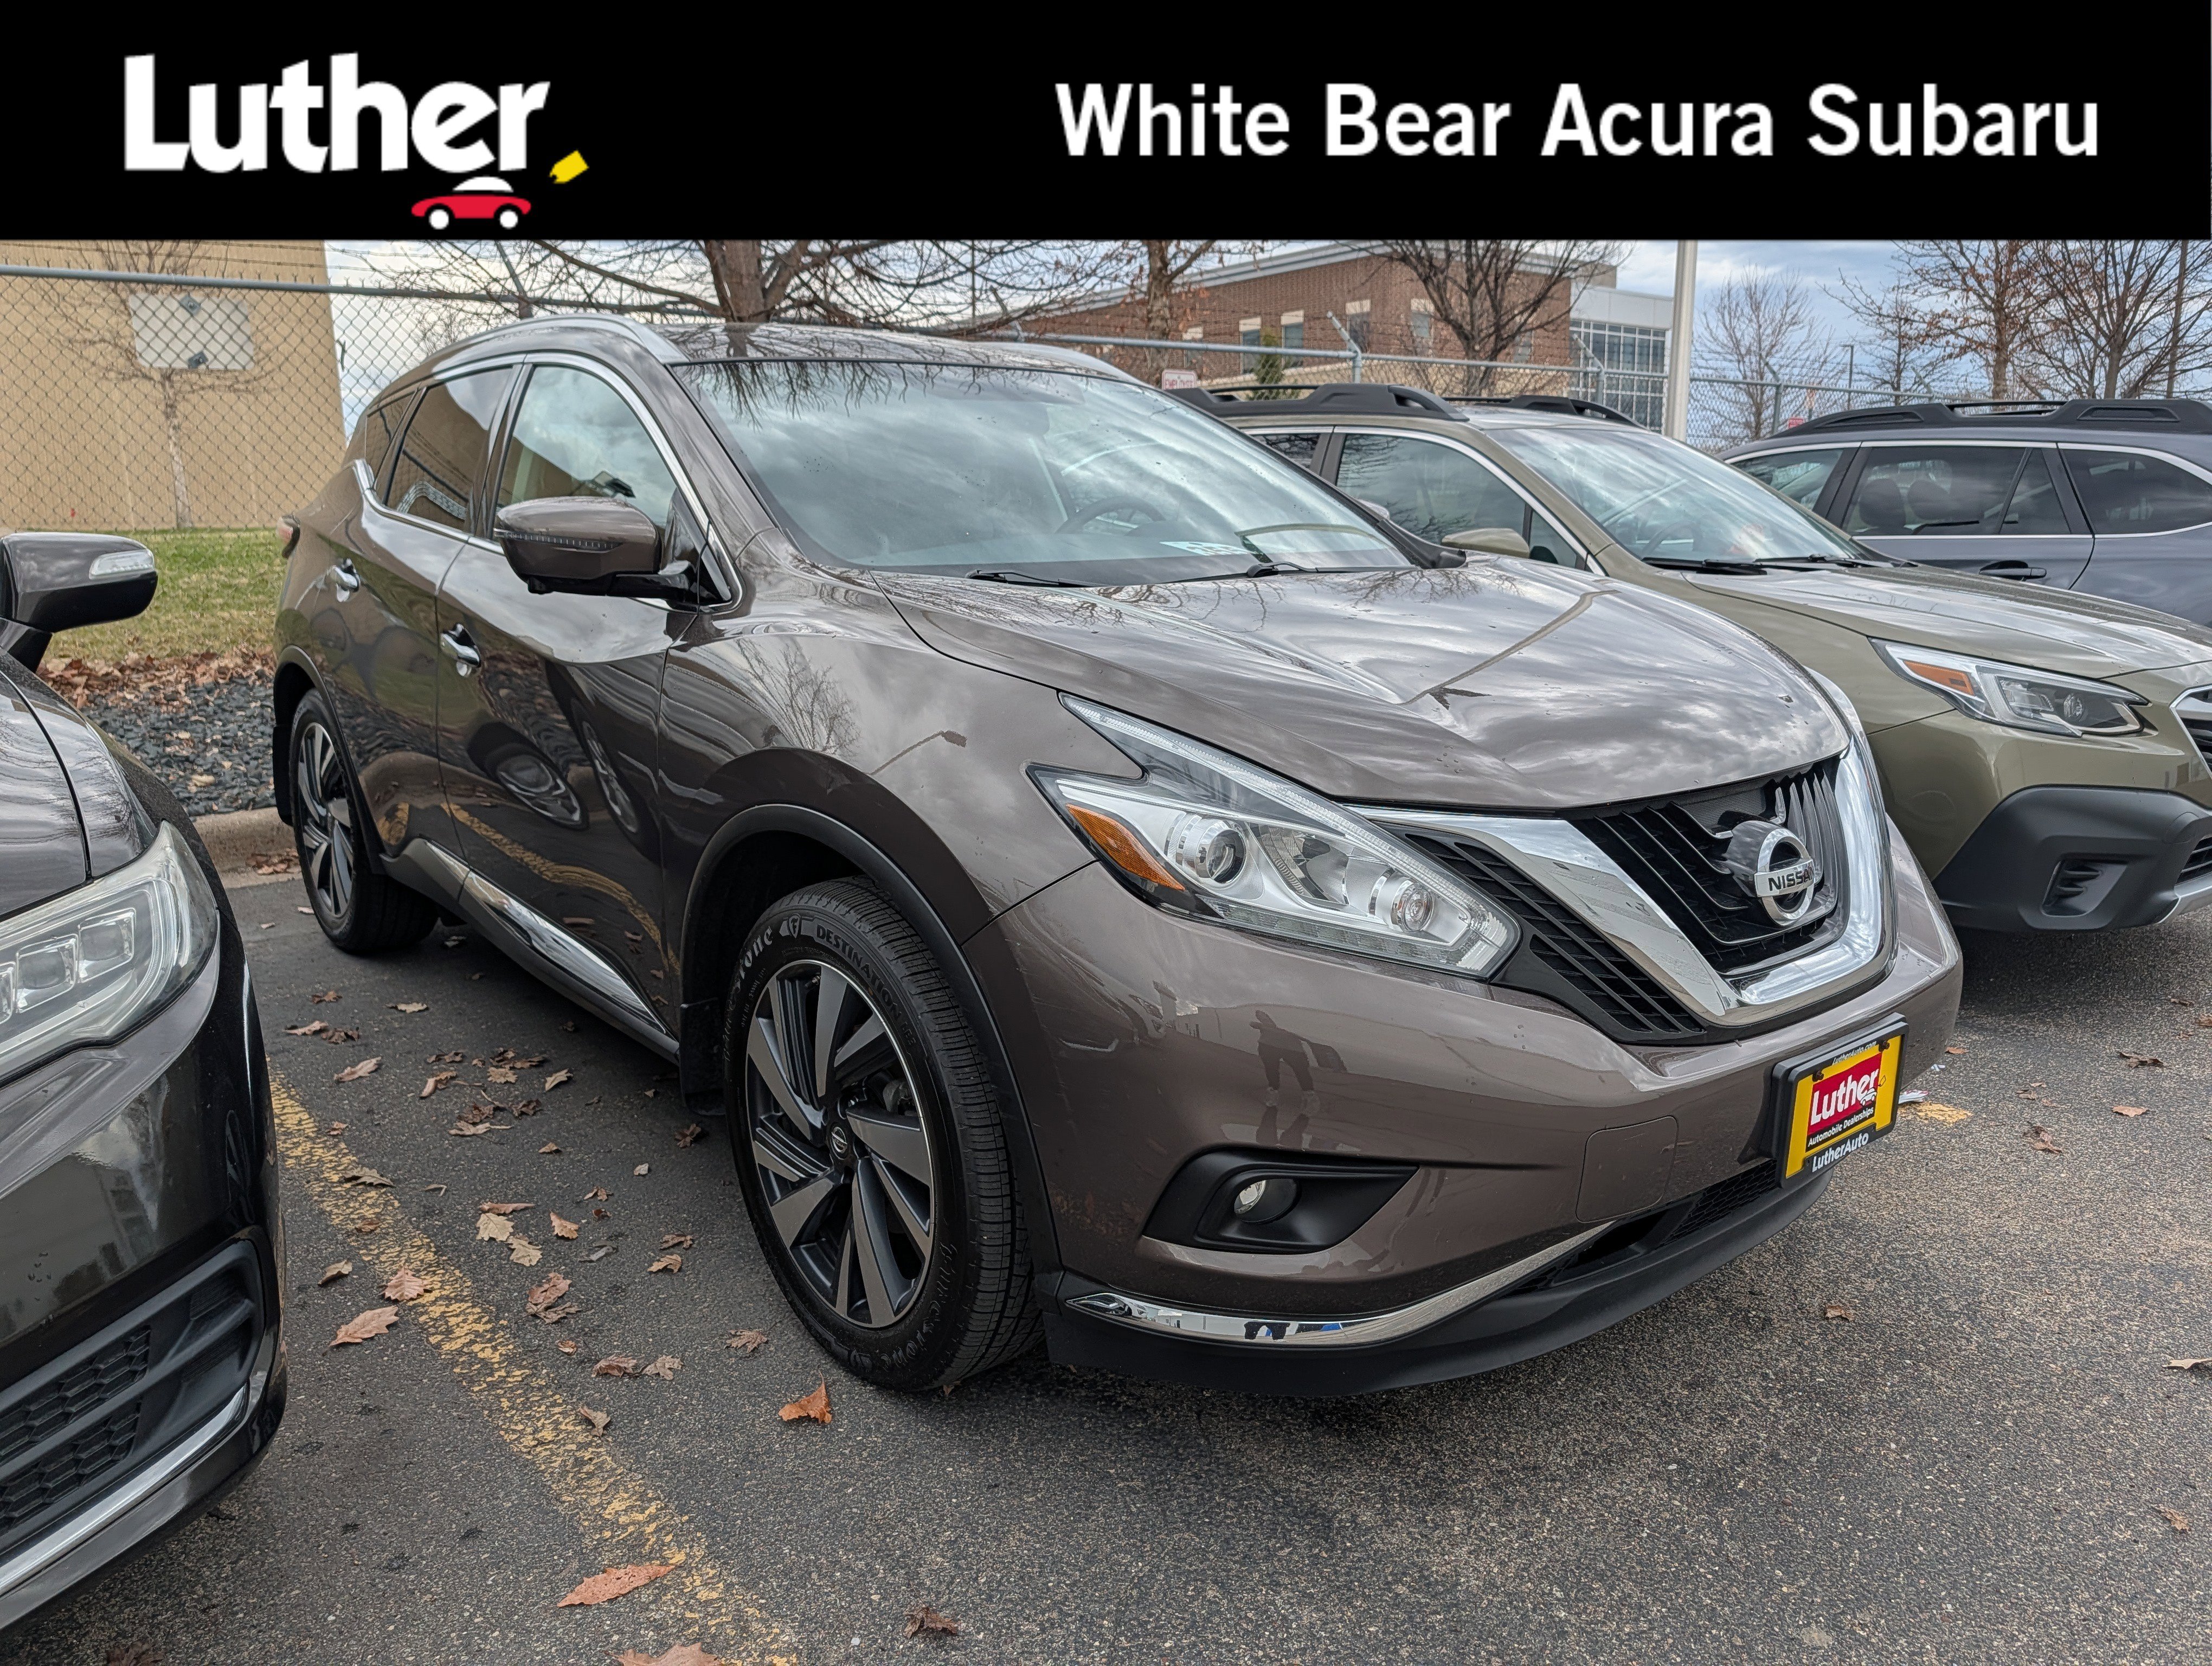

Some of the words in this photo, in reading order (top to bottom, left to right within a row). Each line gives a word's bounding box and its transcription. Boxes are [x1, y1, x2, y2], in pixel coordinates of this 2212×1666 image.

[1768, 866, 1814, 892] NISSAN
[816, 924, 902, 1021] DESTINATION
[1832, 1041, 1877, 1066] LutherAuto.com
[1810, 1068, 1880, 1126] Luther
[1808, 1123, 1842, 1147] Automobile
[1843, 1107, 1874, 1128] Dealerships
[1811, 1133, 1869, 1173] LutherAuto
